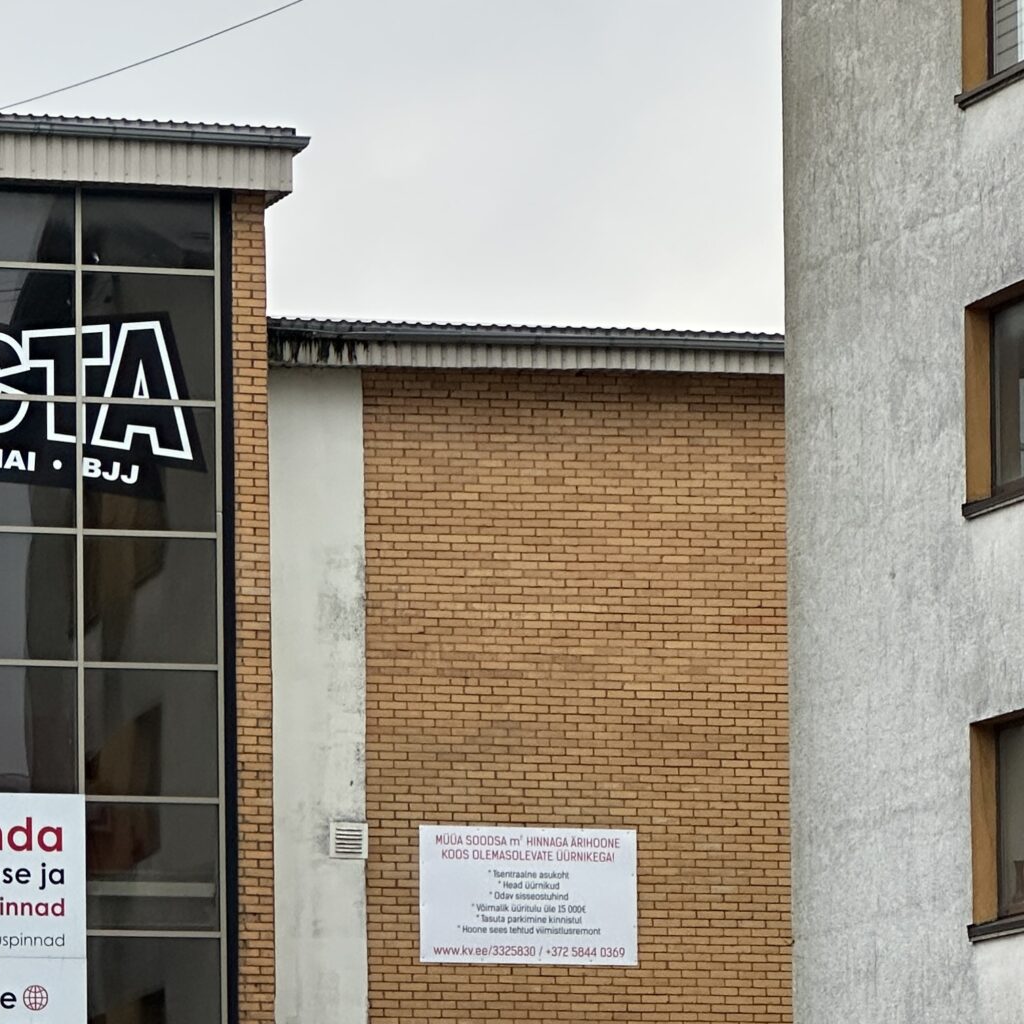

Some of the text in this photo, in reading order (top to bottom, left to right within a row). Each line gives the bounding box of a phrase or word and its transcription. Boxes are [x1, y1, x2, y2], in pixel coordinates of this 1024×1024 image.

[81, 457, 140, 484] BJJ
[435, 833, 463, 846] MÜÜA
[466, 834, 507, 846] SOODSA
[526, 836, 569, 848] HINNAGA
[571, 835, 621, 849] ÄRIHOONE
[442, 849, 469, 860] KOOS
[473, 849, 553, 861] OLEMASOLEVATE
[39, 862, 65, 890] ja
[493, 869, 569, 879] Tsentraalne asukoht
[503, 880, 560, 890] Head üürnikud
[494, 891, 569, 901] Odav sisseostuhind
[476, 903, 509, 912] Võimalik
[544, 904, 556, 913] üle
[558, 905, 566, 913] 15
[568, 905, 587, 913] 000€
[481, 914, 582, 924] Tasuta parkimine kinnistul
[462, 925, 487, 934] Hoone
[509, 926, 534, 934] tehtud
[536, 926, 601, 935] viimistlusremont
[433, 945, 536, 957] www.kv.ee/3325830
[546, 946, 569, 957] +372
[571, 947, 597, 958] 5844
[600, 947, 626, 958] 0369
